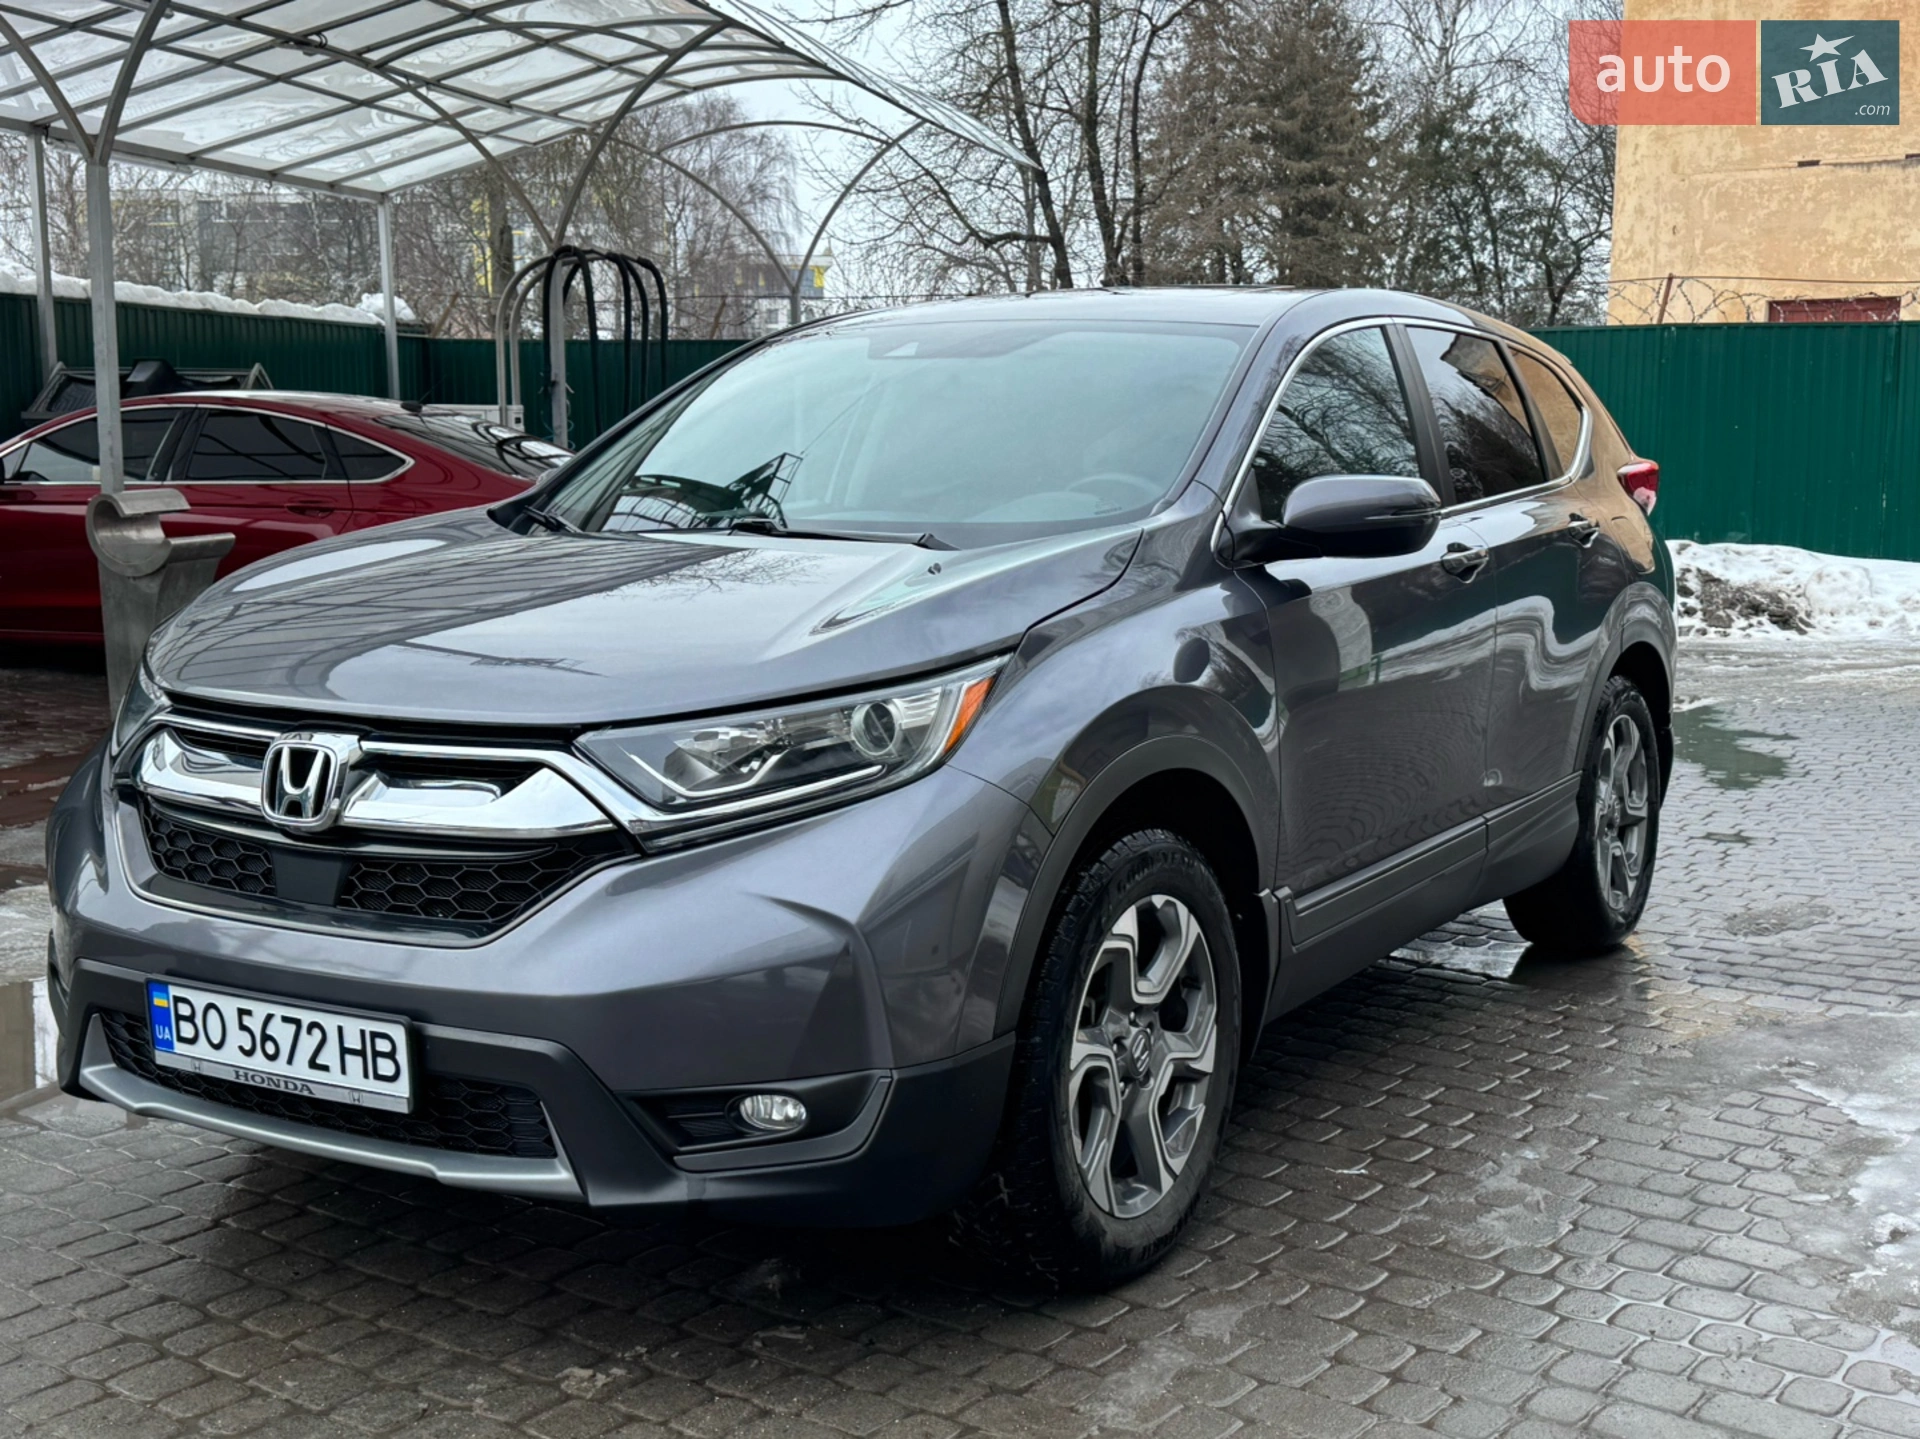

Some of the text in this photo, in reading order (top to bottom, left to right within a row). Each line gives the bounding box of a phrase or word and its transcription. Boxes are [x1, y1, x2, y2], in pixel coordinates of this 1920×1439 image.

[155, 1024, 172, 1041] UA
[172, 994, 401, 1084] BO 5672 HB
[232, 1069, 316, 1096] HONDA
